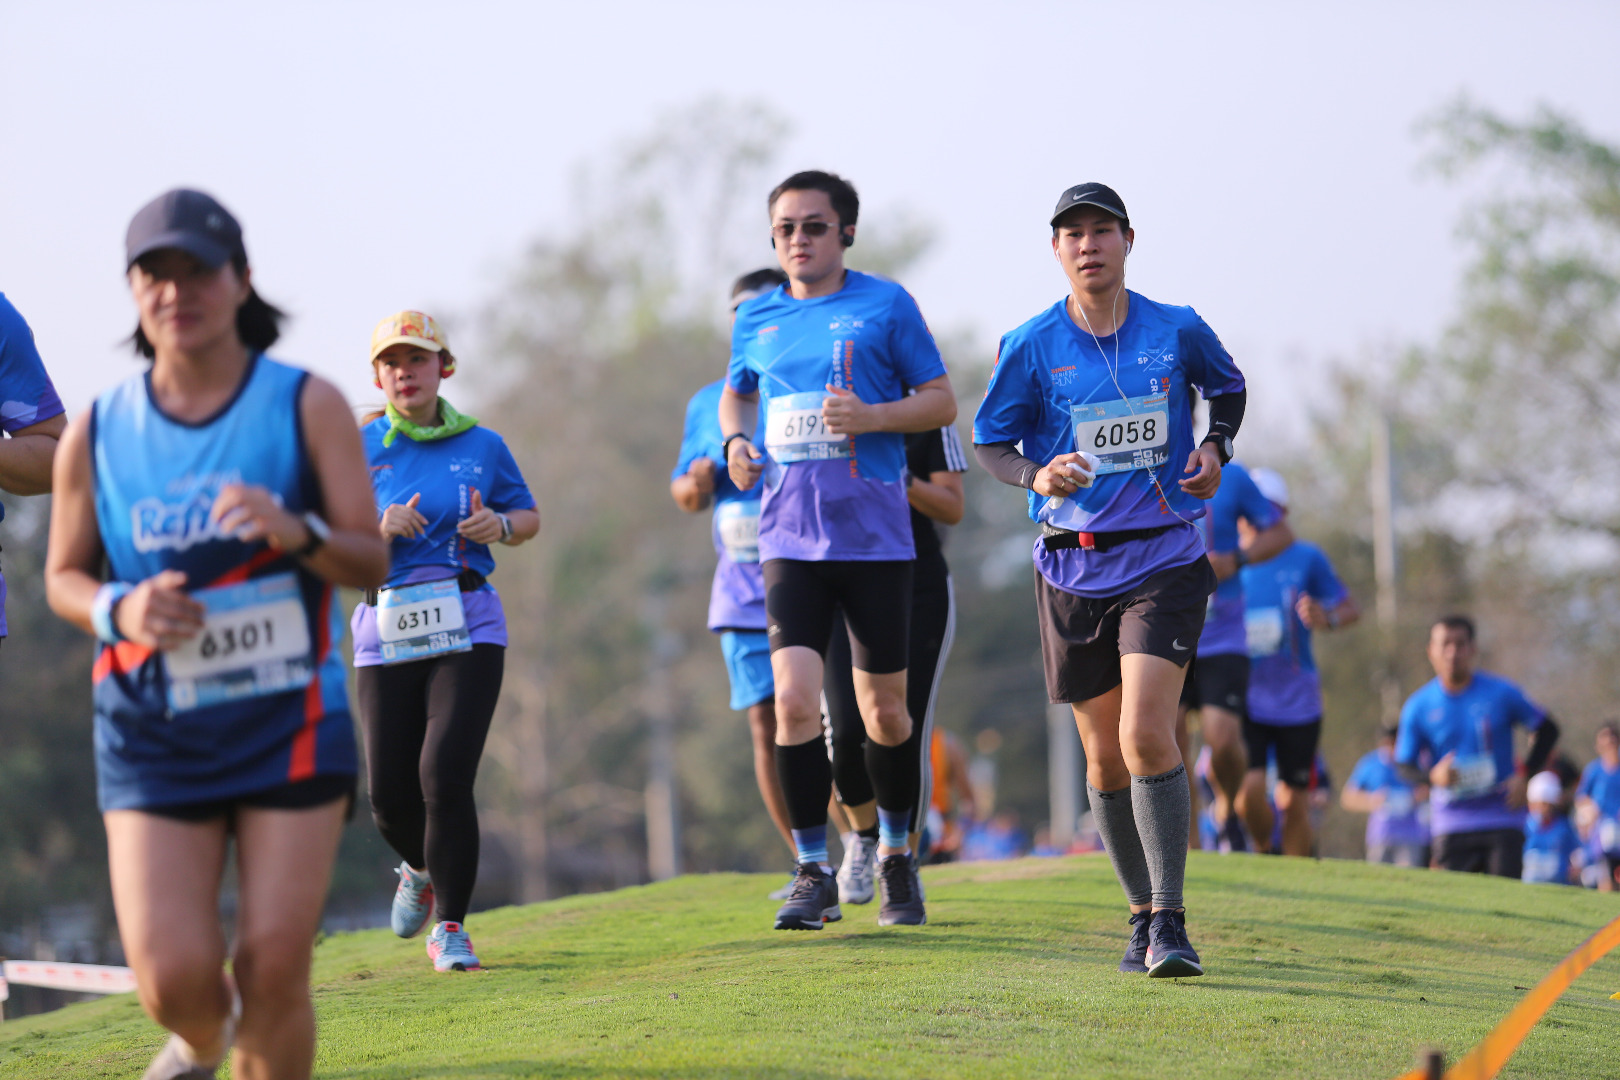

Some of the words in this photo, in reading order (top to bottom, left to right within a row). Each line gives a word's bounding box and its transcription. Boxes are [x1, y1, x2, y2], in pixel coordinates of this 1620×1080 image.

[844, 340, 854, 381] SINGHA
[1051, 365, 1077, 374] SINGHA
[1137, 356, 1149, 365] SP
[1162, 353, 1174, 362] XC
[1094, 418, 1156, 448] 6058
[1154, 452, 1164, 465] 16
[397, 607, 441, 631] 6311
[200, 618, 274, 660] 6301
[1138, 765, 1185, 785] ZENSAH
